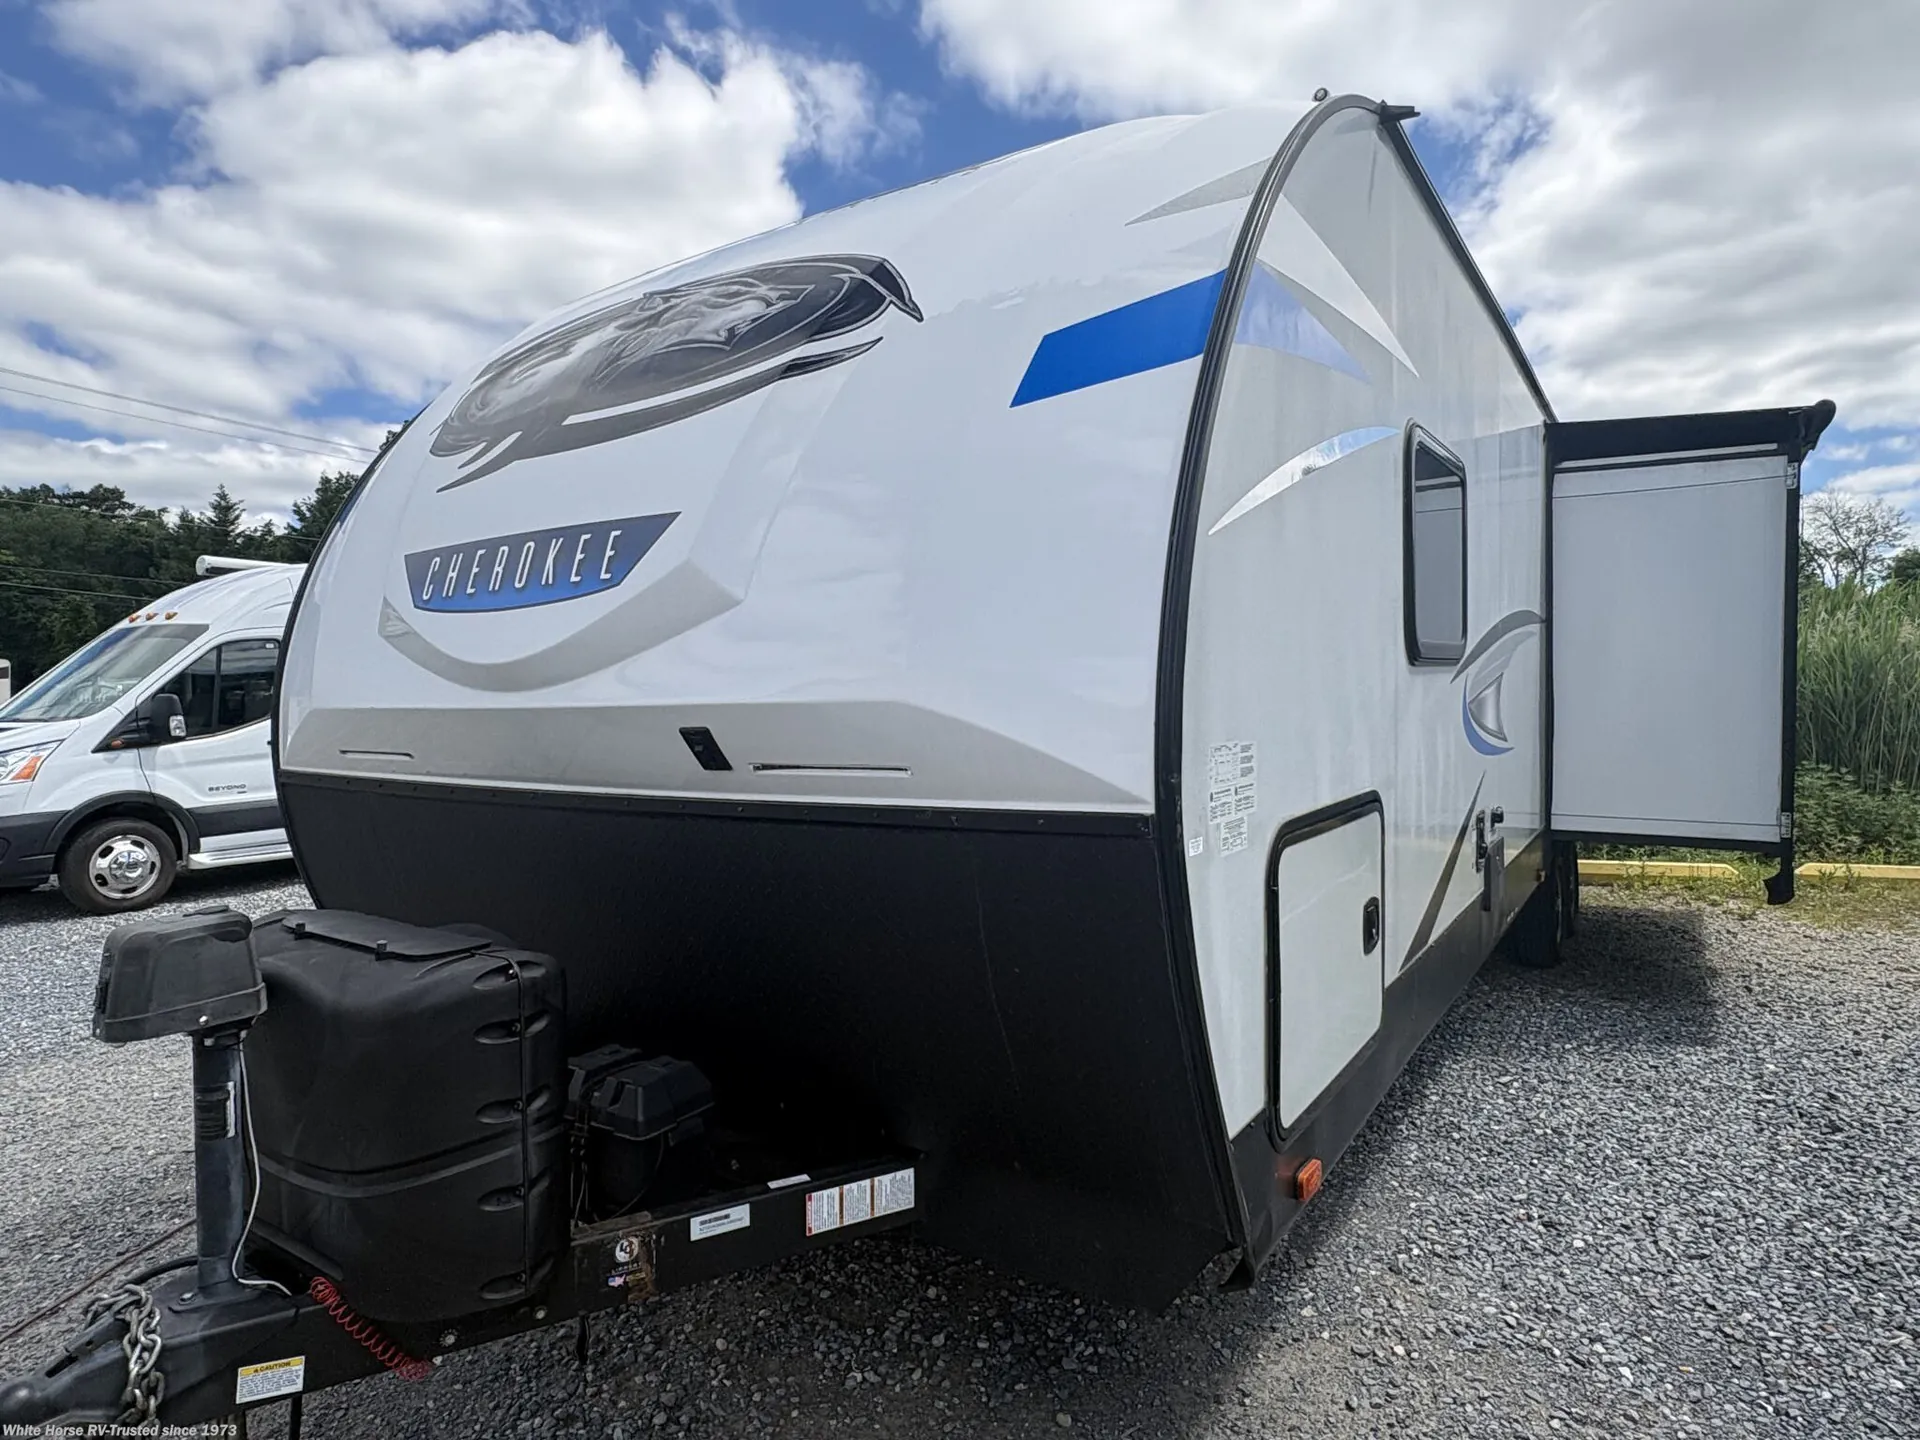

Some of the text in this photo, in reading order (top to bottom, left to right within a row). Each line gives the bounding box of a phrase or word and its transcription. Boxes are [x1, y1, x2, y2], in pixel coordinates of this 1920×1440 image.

[421, 529, 624, 602] CHEROKEE
[208, 783, 247, 792] BEYOND
[259, 1360, 291, 1372] CAUTION
